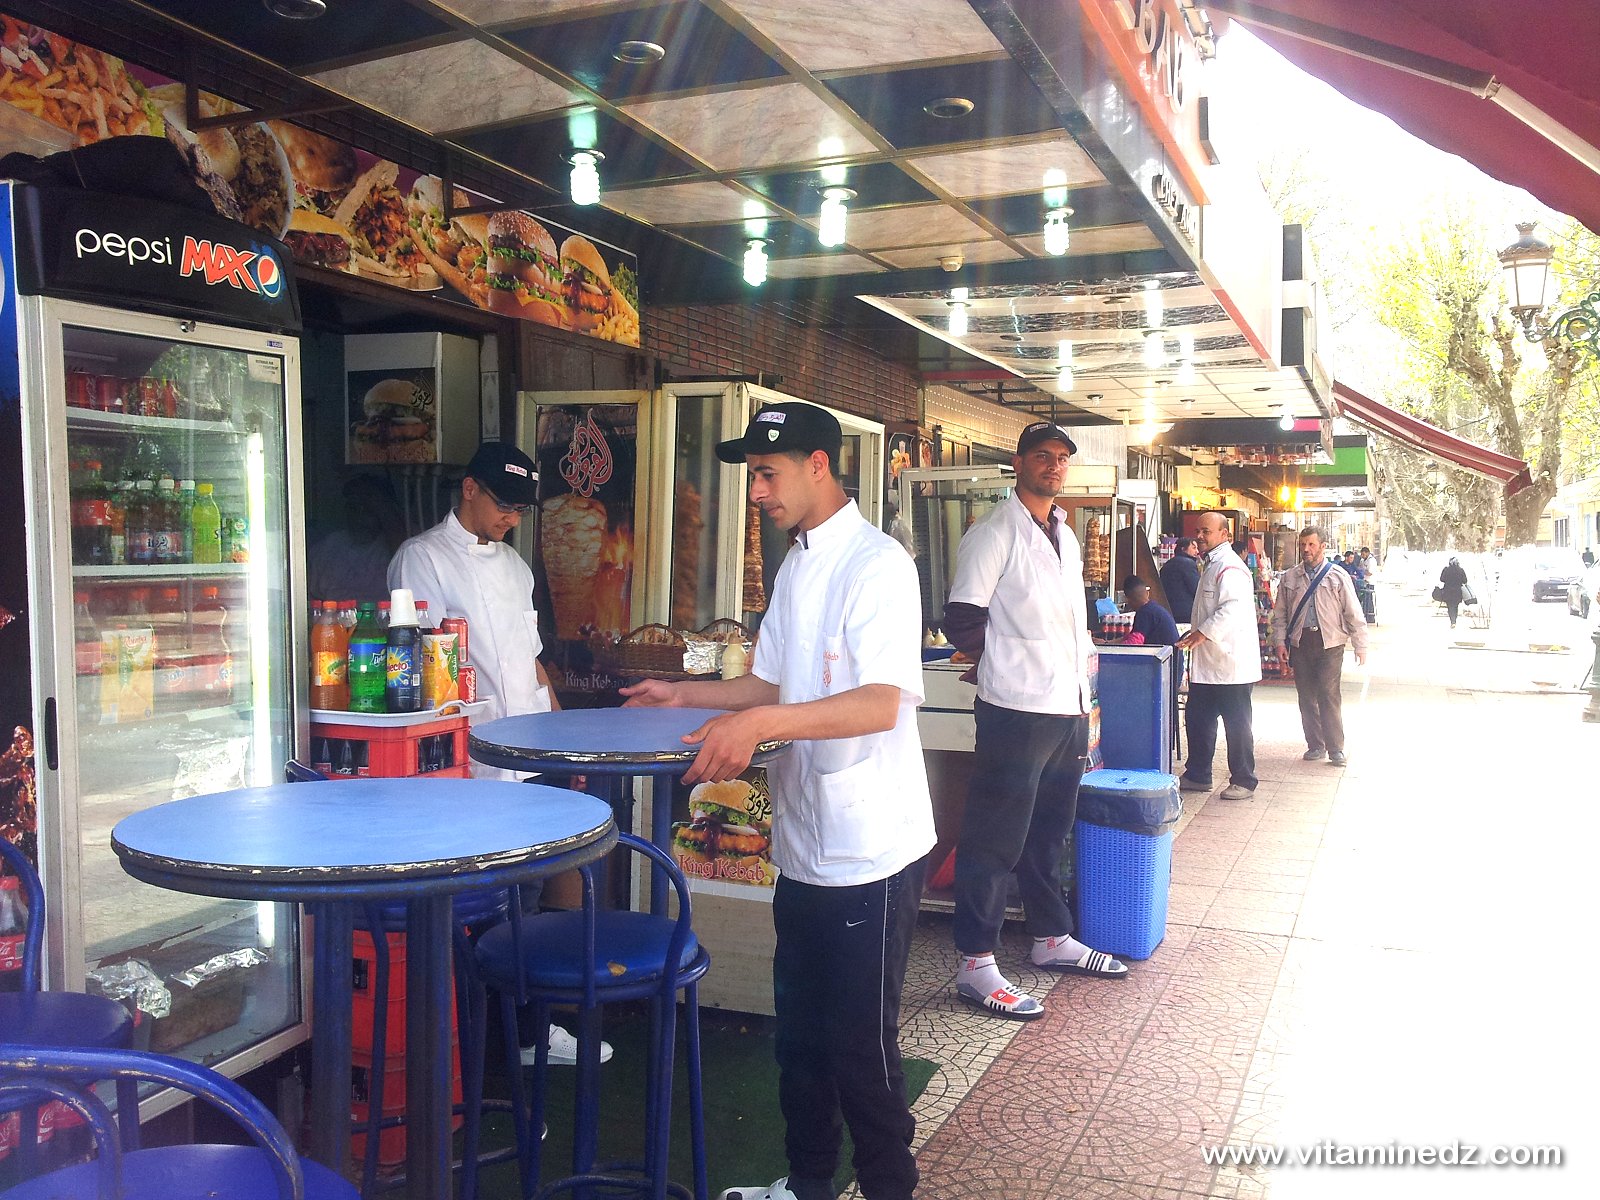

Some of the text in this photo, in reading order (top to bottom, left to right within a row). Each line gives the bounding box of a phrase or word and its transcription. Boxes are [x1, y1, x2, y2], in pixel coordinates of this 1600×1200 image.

[75, 228, 260, 294] pepsi MAX
[565, 672, 590, 690] King
[678, 855, 765, 881] King Kebab
